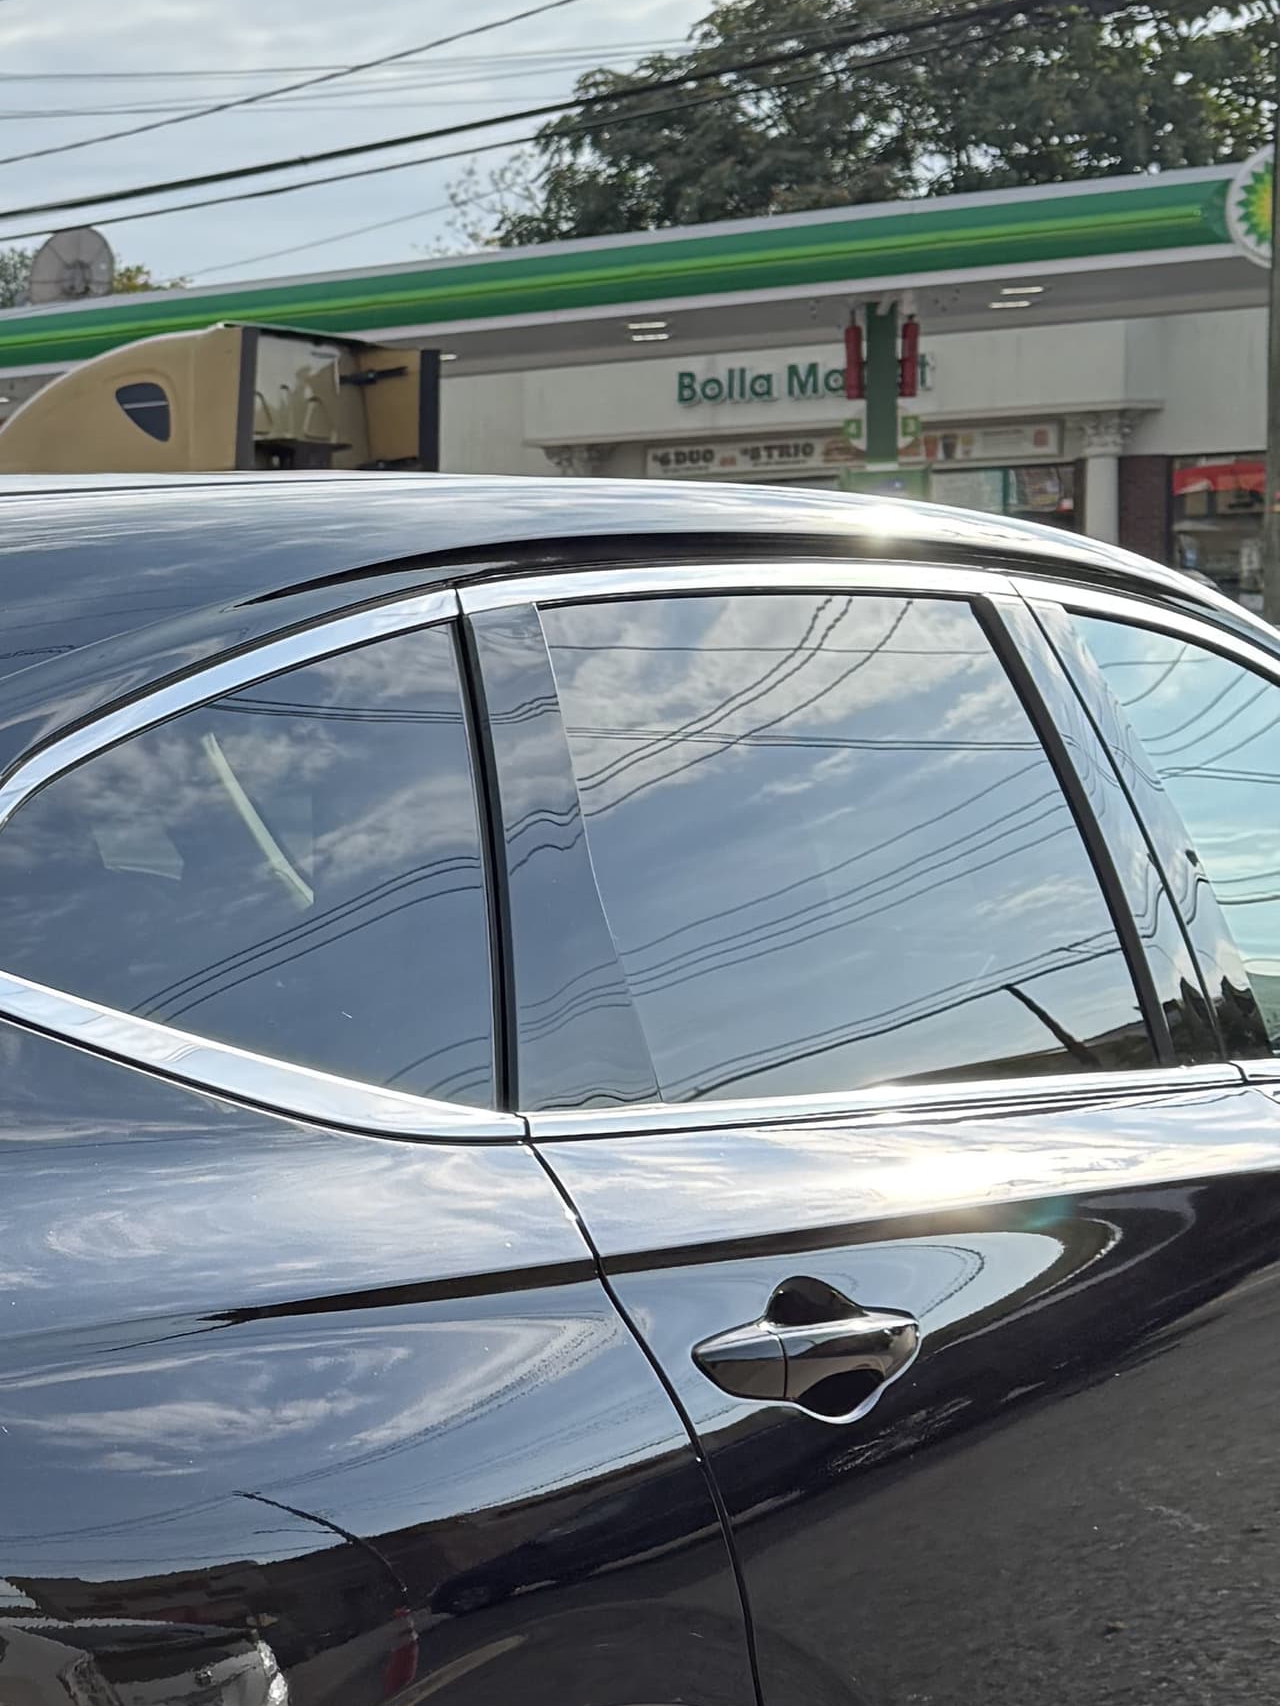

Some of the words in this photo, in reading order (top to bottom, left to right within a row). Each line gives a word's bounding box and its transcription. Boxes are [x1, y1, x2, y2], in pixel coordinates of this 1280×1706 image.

[677, 367, 773, 403] Bolla
[787, 354, 930, 396] Mat
[674, 447, 715, 465] DUO
[762, 442, 814, 459] TRIO
